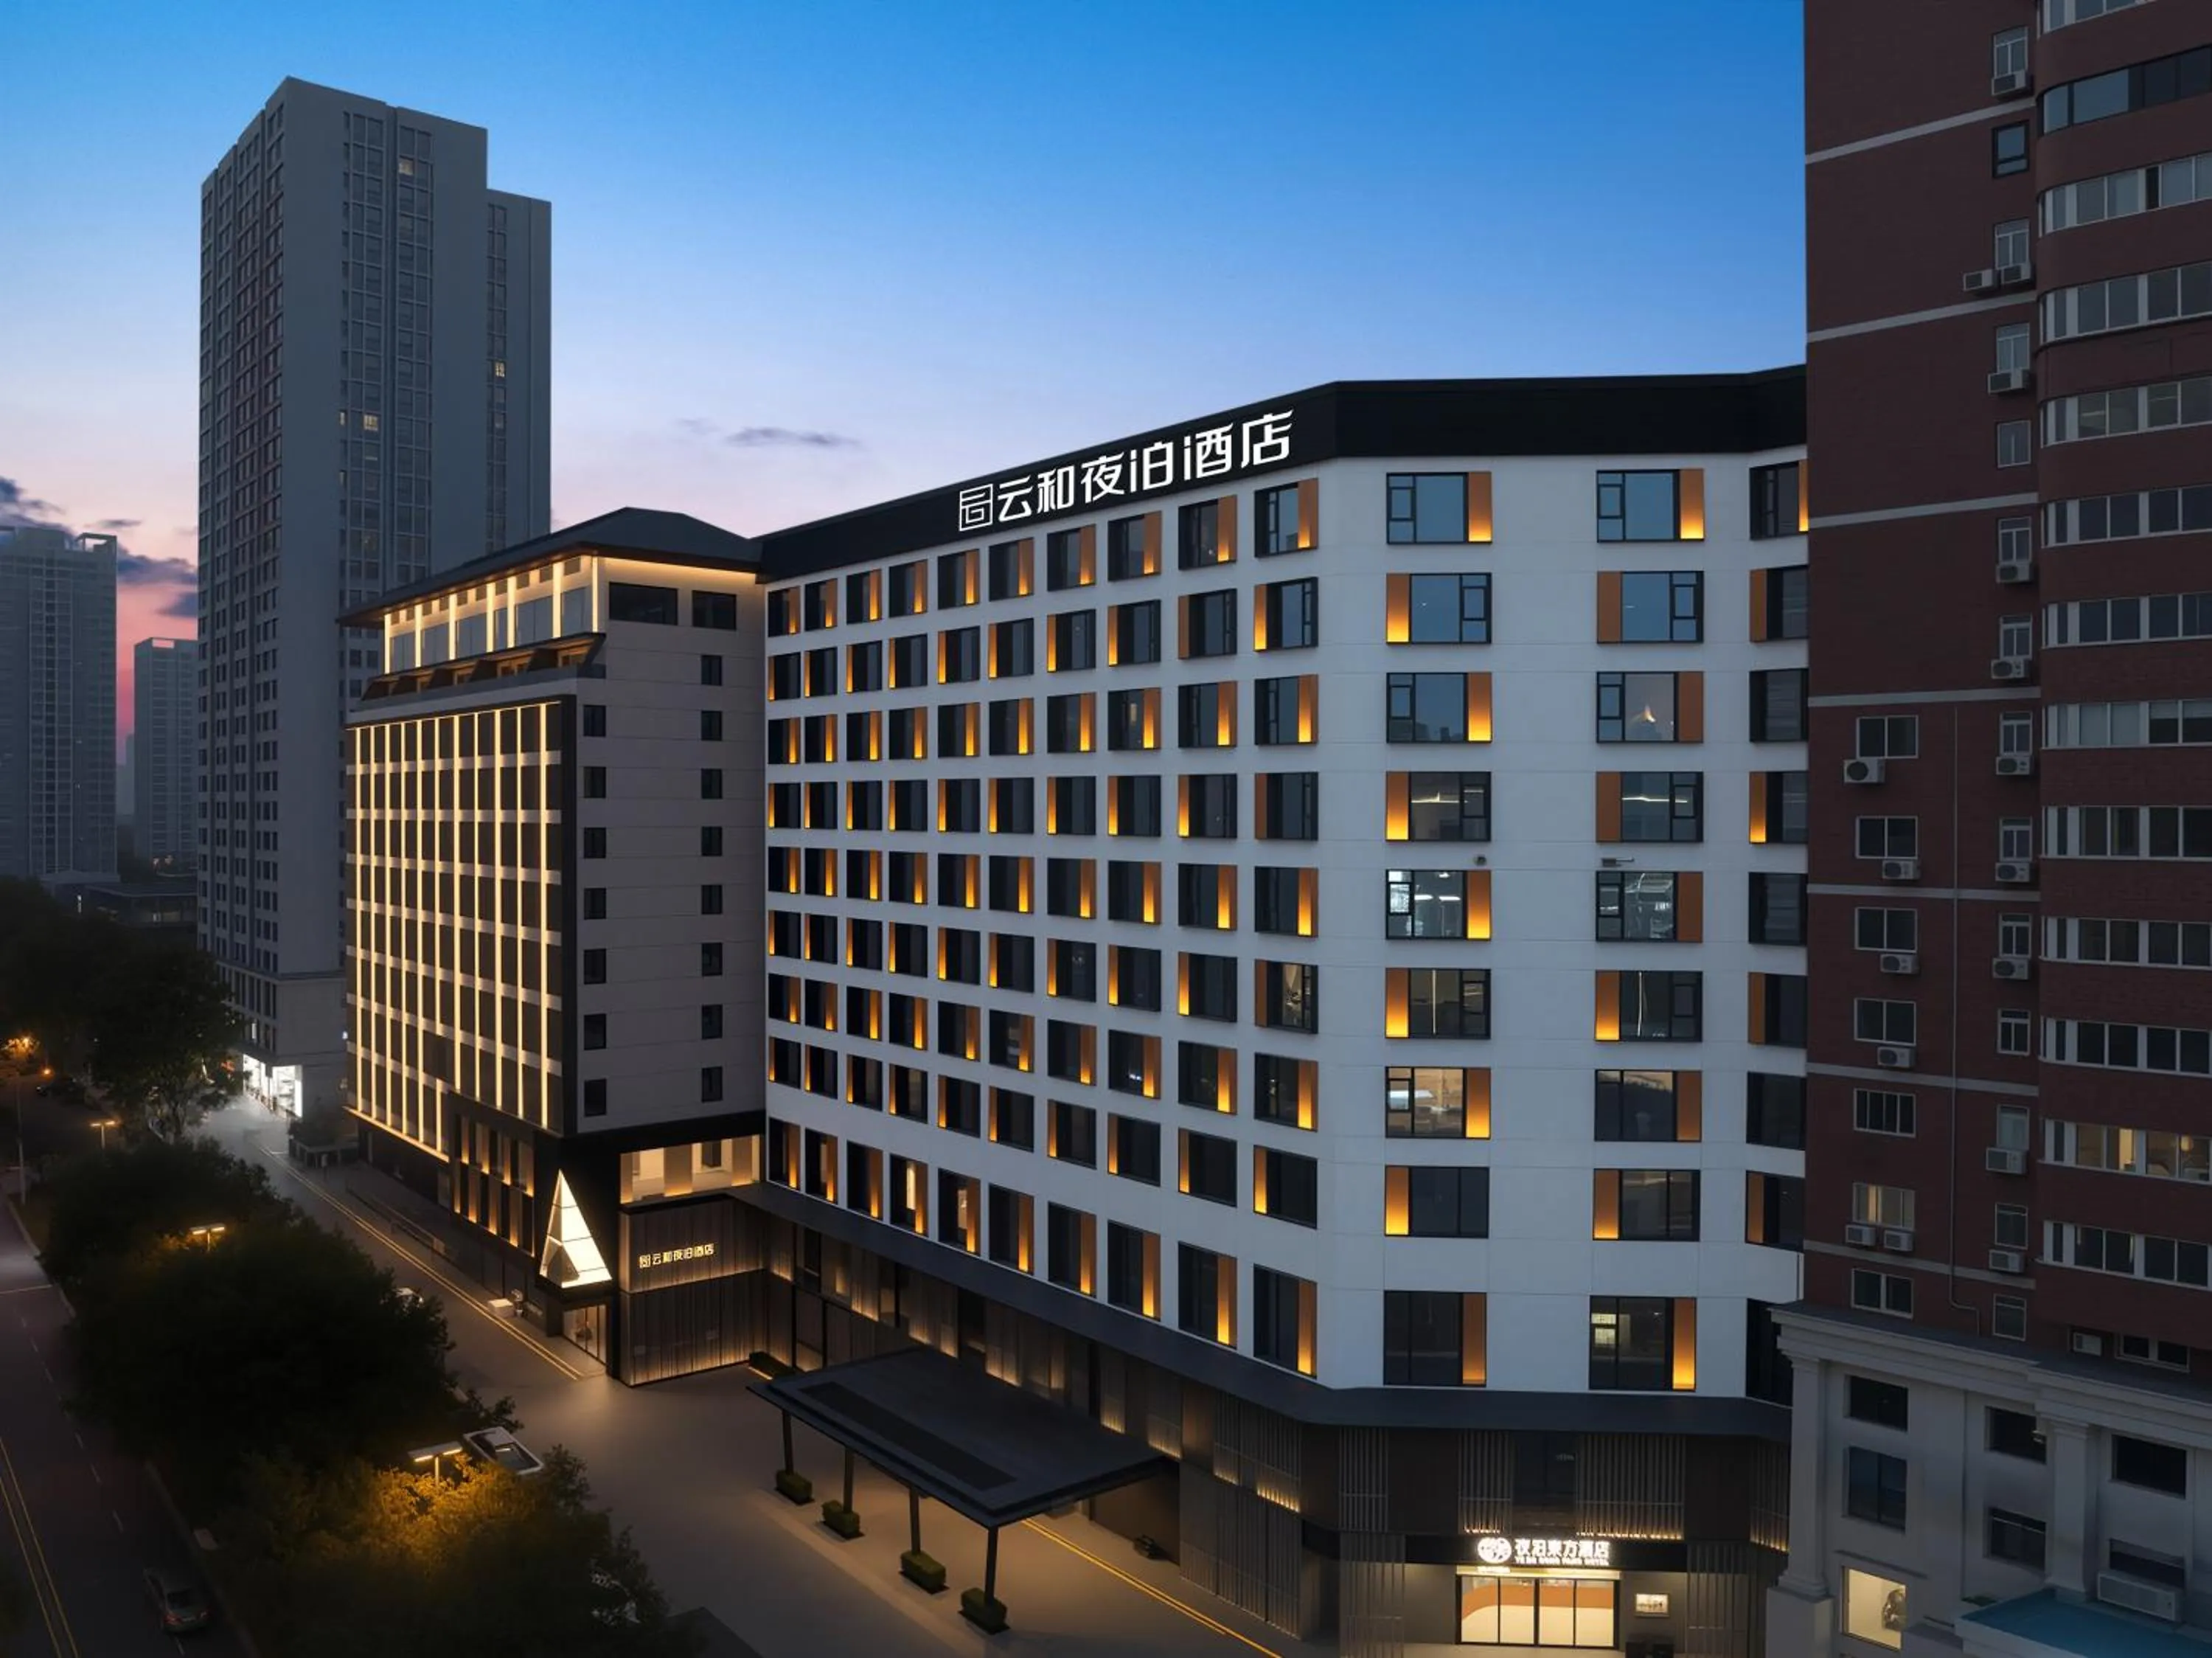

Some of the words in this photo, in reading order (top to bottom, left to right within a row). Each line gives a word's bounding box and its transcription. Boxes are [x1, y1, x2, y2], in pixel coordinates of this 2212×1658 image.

[997, 409, 1294, 523] 云和夜泊酒店
